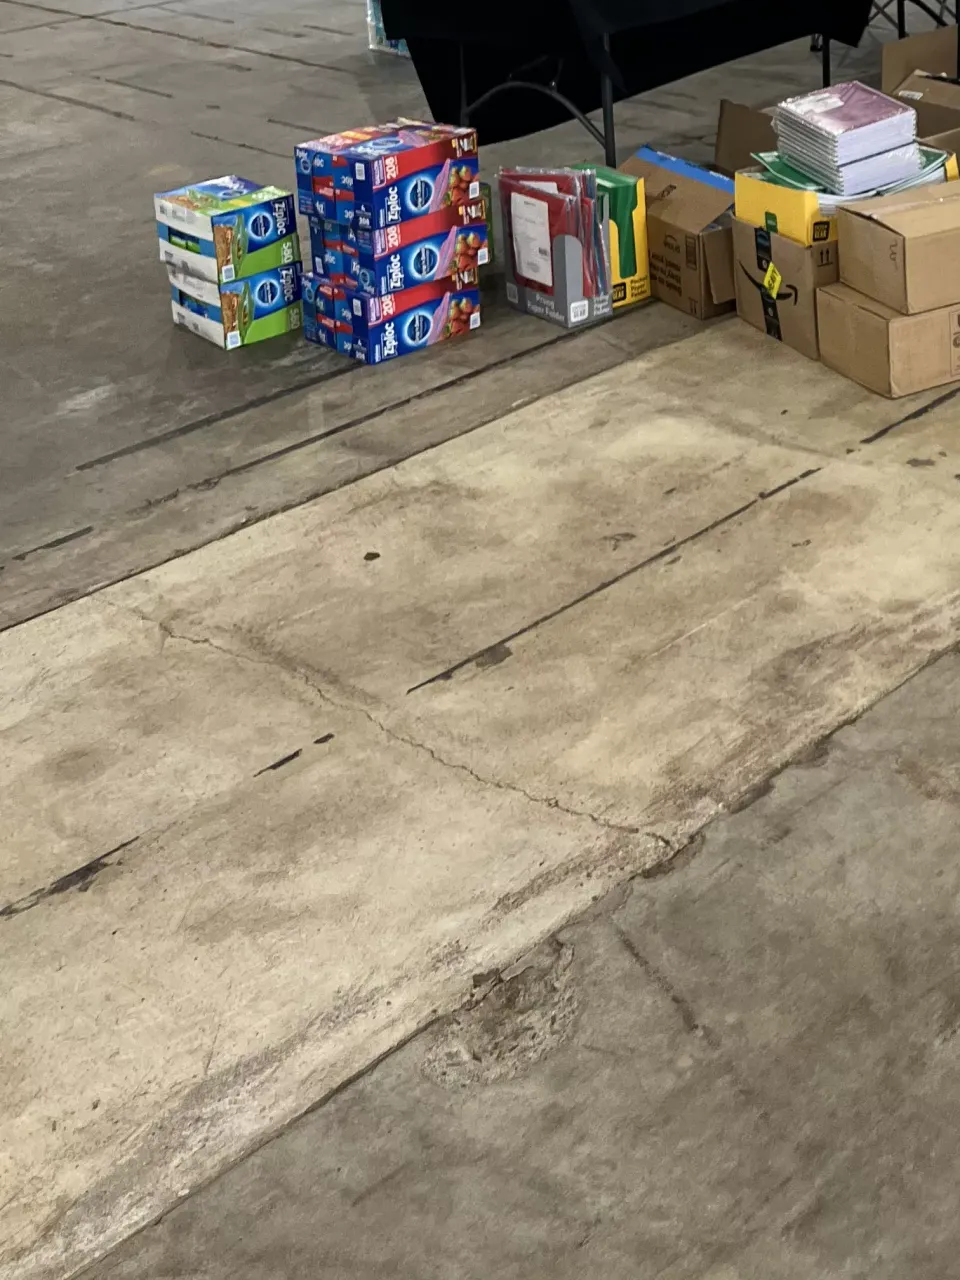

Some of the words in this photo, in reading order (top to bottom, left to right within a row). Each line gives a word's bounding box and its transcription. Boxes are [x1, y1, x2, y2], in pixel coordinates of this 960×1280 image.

[385, 156, 397, 179] 208
[275, 201, 286, 235] Ziploc
[388, 186, 401, 222] Ziploc
[387, 226, 399, 248] 208
[282, 242, 293, 263] 580
[281, 268, 293, 301] Ziploc
[391, 253, 404, 289] Ziploc
[290, 308, 299, 329] 580
[382, 294, 393, 316] 208
[384, 321, 398, 357] Ziploc
